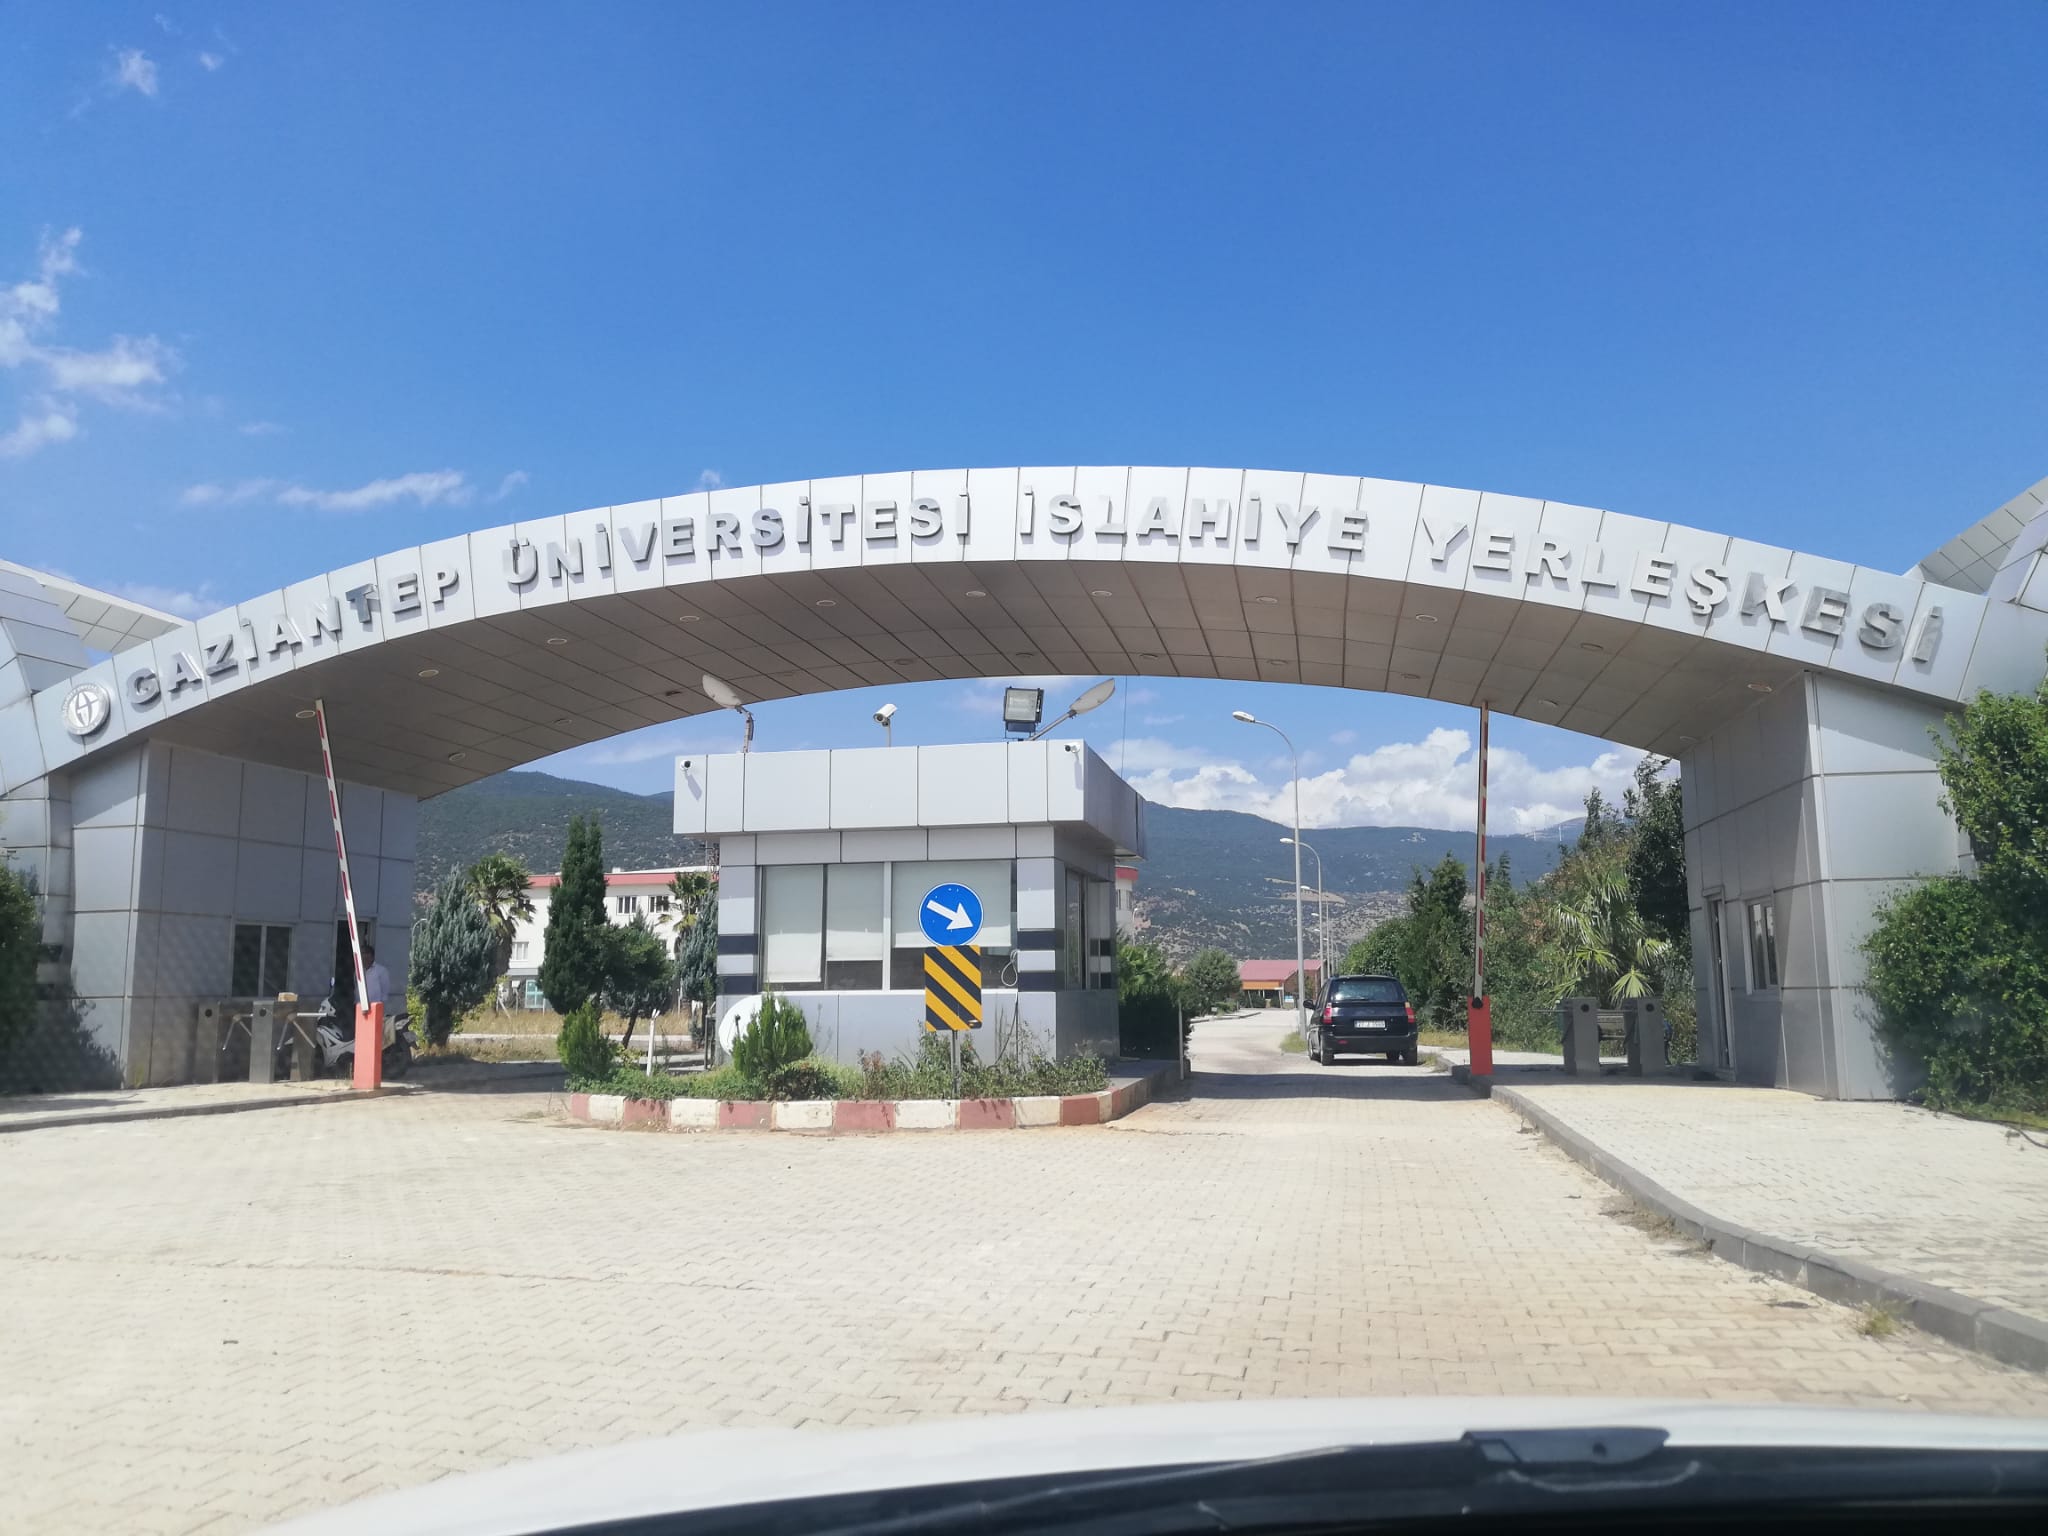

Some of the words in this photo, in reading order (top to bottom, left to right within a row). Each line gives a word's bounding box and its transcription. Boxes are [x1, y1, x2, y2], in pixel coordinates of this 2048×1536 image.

[129, 569, 458, 705] GAZİANTEP
[504, 489, 968, 584] ÜNİVERSİTESİ
[1019, 486, 1367, 552] İSLAHİYE
[1423, 517, 1943, 663] YERLEŞKESİ
